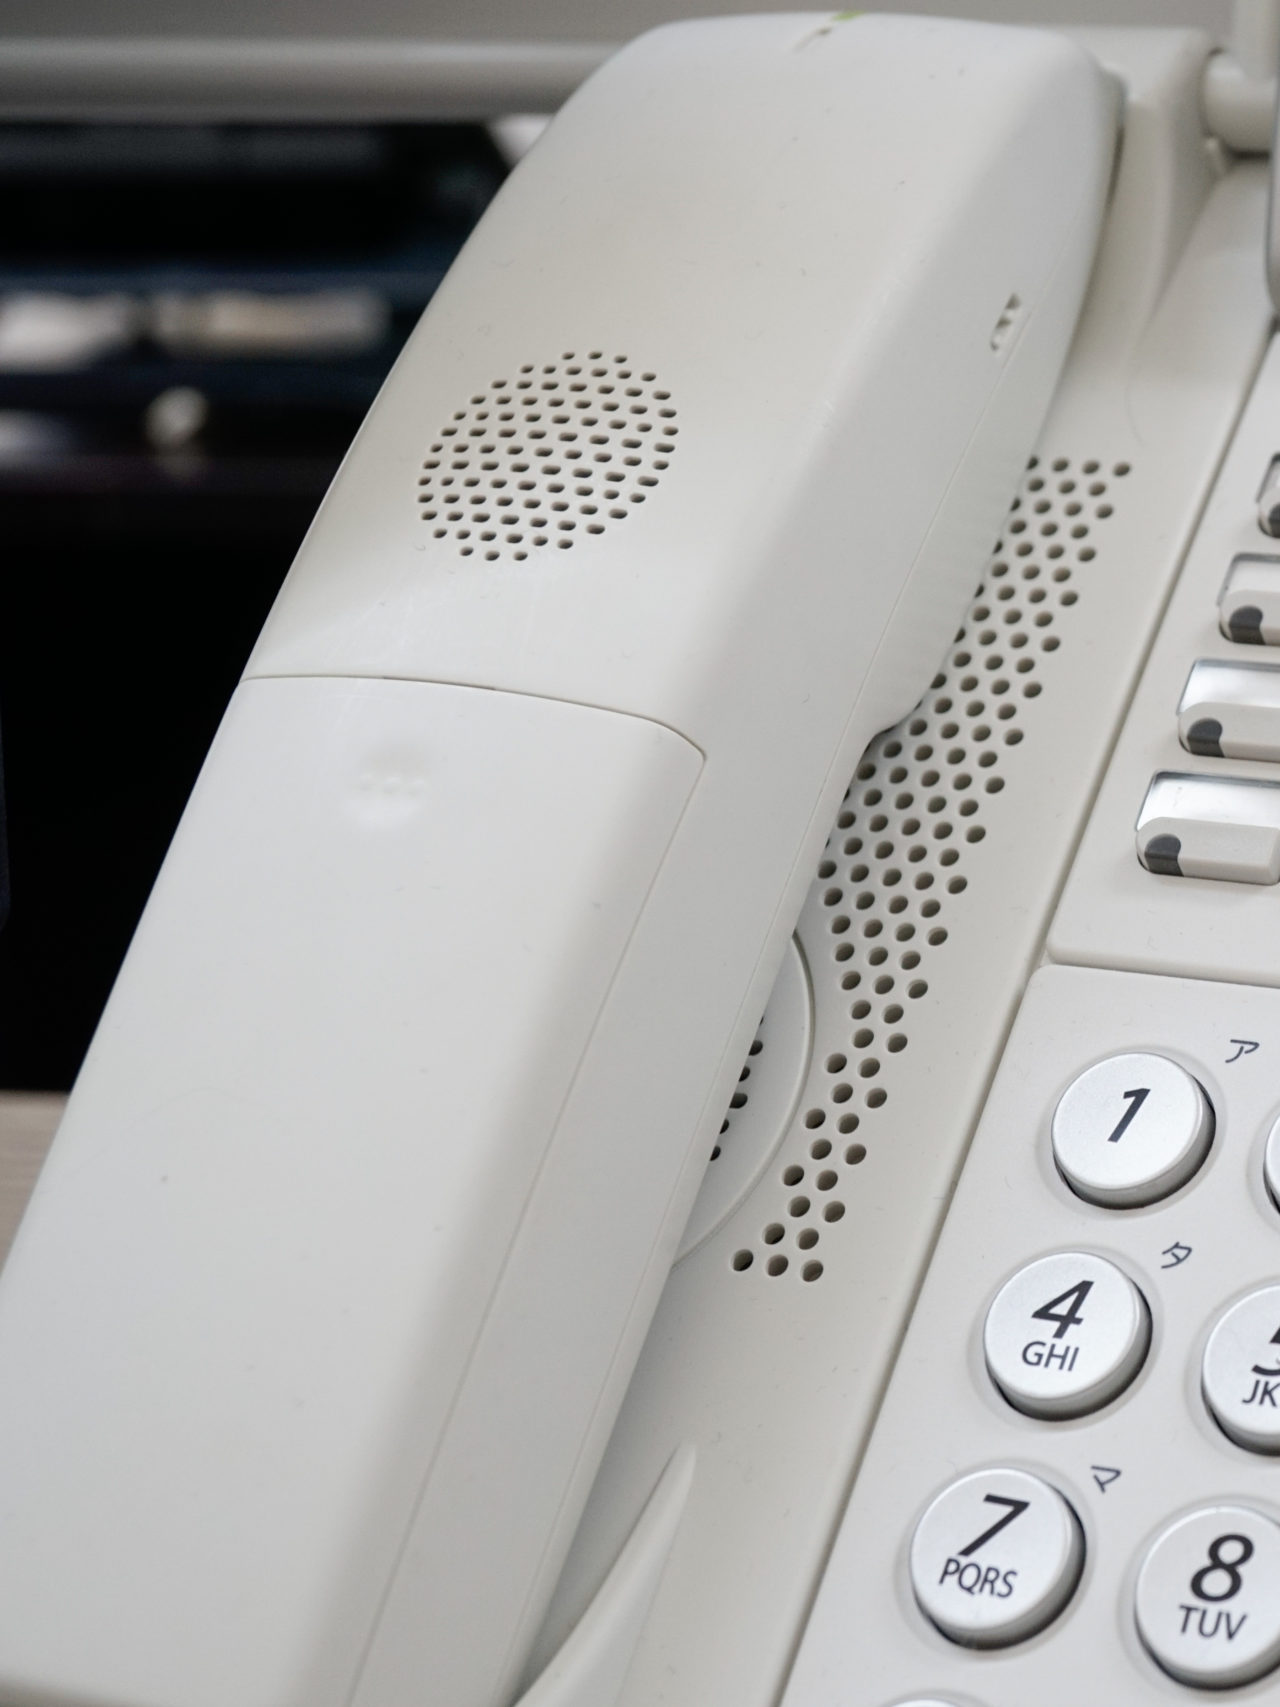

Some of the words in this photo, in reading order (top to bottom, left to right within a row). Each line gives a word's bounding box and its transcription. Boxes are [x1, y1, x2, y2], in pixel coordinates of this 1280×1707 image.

[1225, 1038, 1260, 1063] ア
[1107, 1087, 1151, 1144] 1
[1160, 1241, 1193, 1269] タ
[1031, 1279, 1095, 1339] 4
[1021, 1340, 1080, 1373] GHI
[1090, 1464, 1122, 1494] マ
[957, 1493, 1031, 1557] 7
[938, 1557, 1018, 1600] PQRS
[1190, 1533, 1255, 1603] 8
[1178, 1604, 1248, 1641] TUV
